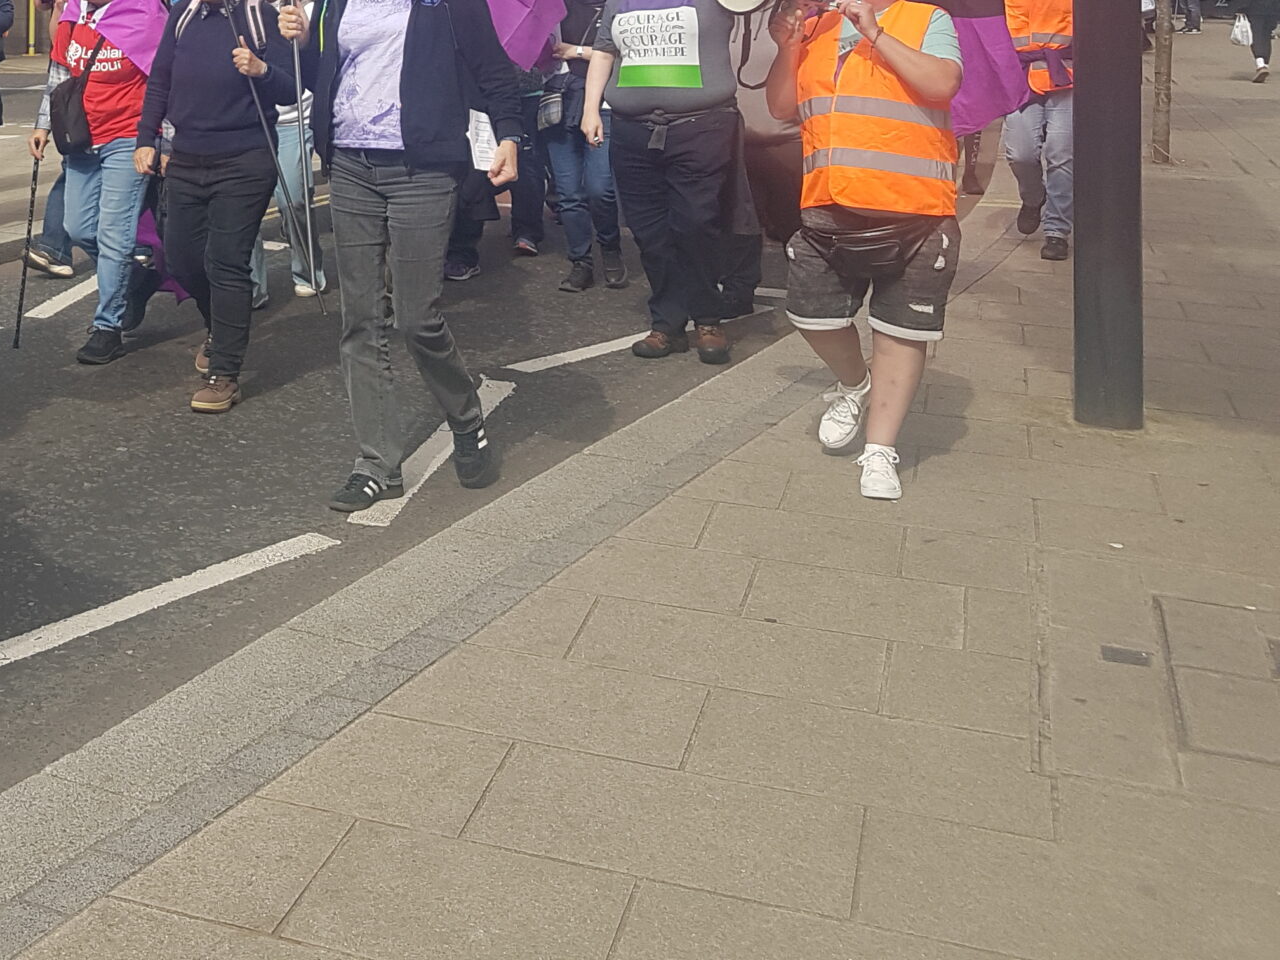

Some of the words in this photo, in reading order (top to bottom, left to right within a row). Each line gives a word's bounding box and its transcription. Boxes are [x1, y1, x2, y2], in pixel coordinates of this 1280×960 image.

[618, 11, 685, 27] COURAGE
[629, 24, 656, 35] calls
[660, 23, 672, 33] to
[622, 32, 687, 48] COURAGE
[80, 58, 122, 72] Lbou
